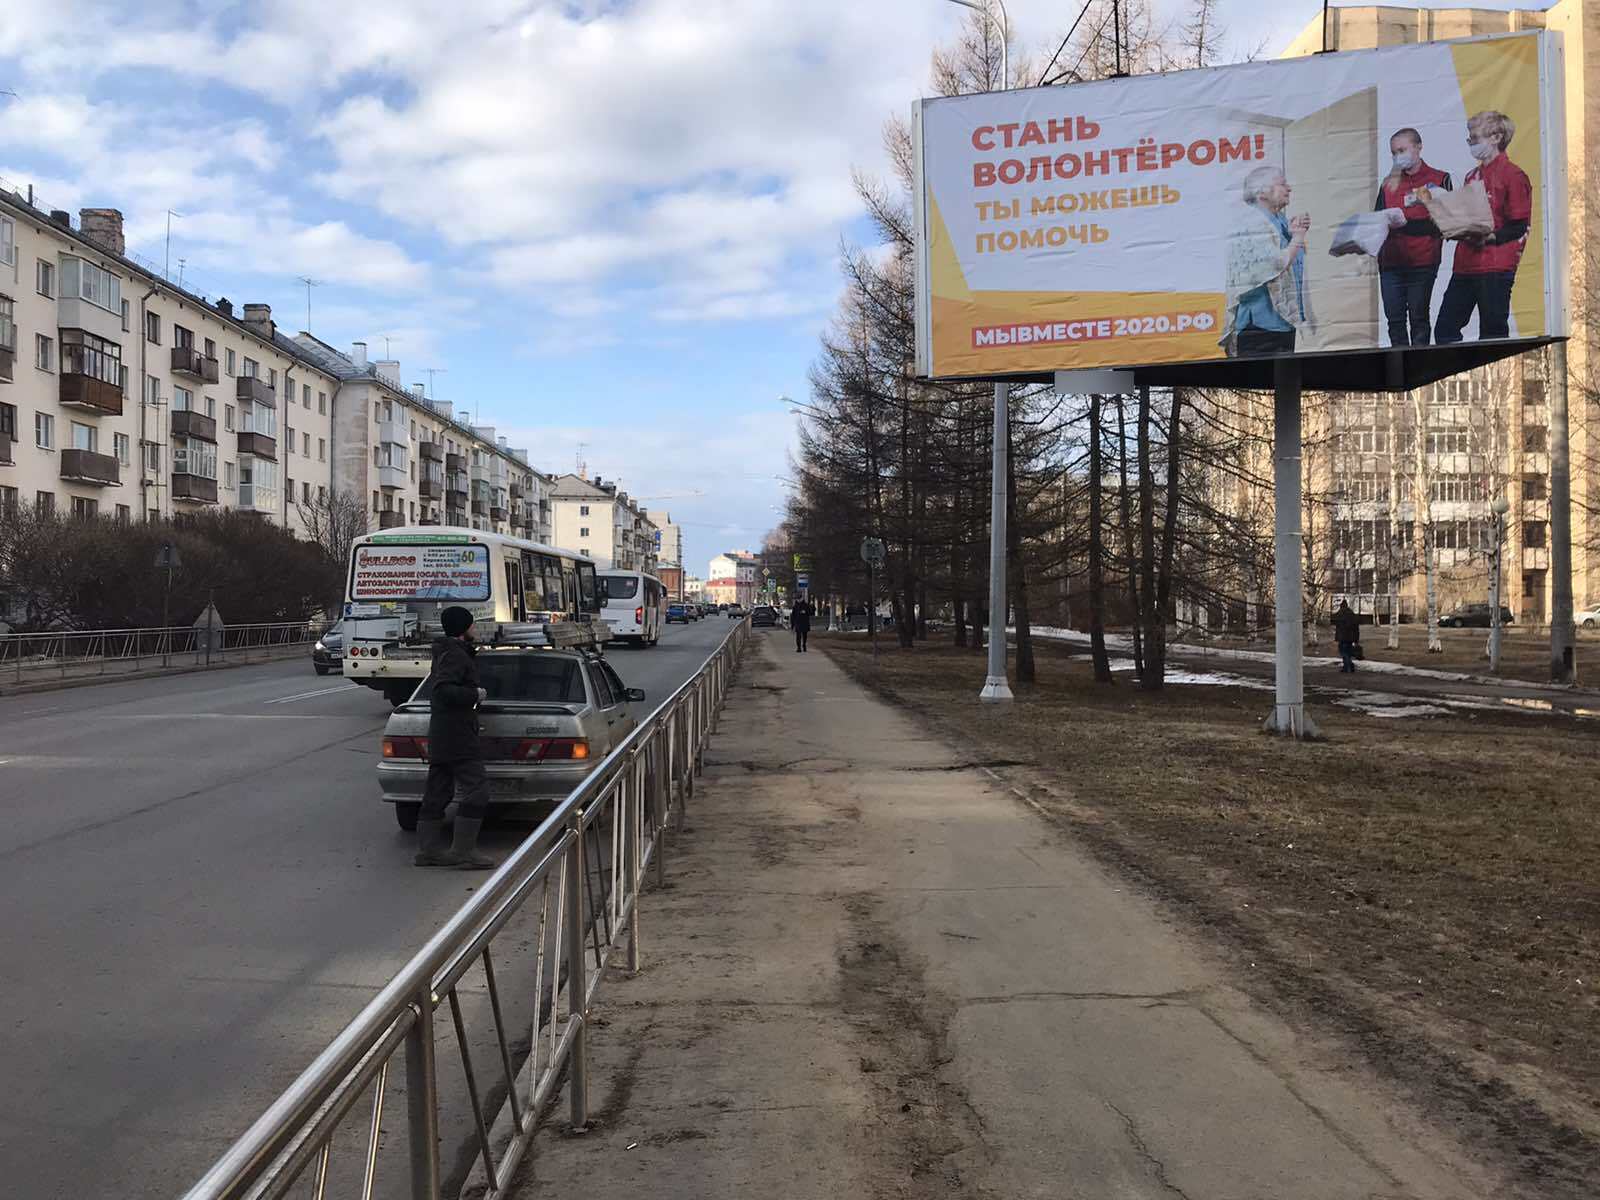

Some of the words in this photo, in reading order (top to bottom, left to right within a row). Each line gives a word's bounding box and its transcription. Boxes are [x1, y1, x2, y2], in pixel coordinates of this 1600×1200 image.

[971, 115, 1101, 152] СТАНЬ
[973, 133, 1266, 187] ВОЛОНТЁРОМ!
[975, 201, 1021, 222] ТЫ
[1030, 184, 1181, 217] МОЖЕШЬ
[975, 224, 1110, 254] ПОМОЧЬ
[461, 550, 475, 563] 60
